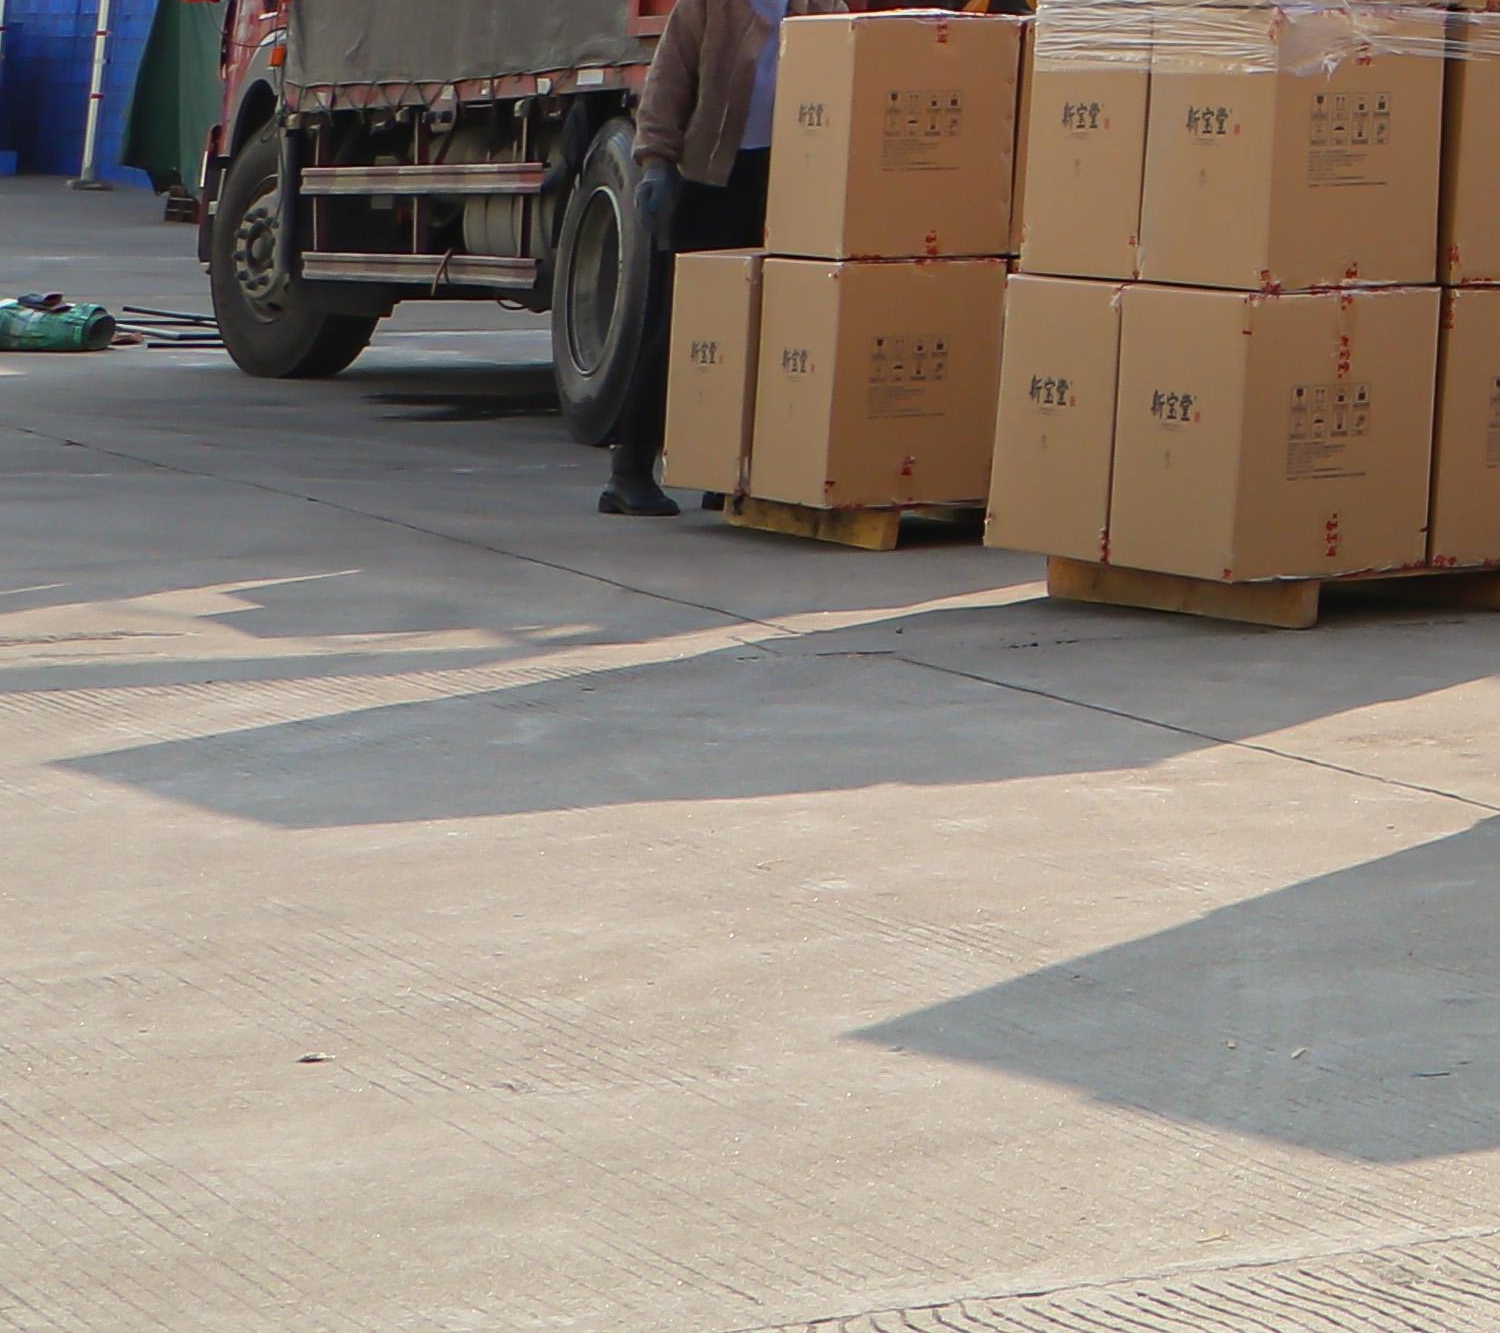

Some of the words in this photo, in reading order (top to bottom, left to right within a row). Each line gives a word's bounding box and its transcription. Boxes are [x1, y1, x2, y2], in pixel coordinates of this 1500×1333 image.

[798, 103, 824, 127] 新宝堂
[1062, 102, 1101, 129] 新宝堂
[1186, 106, 1229, 135] 新宝堂
[690, 341, 717, 365] 新宝堂
[783, 349, 808, 374] 新宝堂
[1029, 375, 1069, 406] 新宝堂
[1151, 390, 1193, 421] 新宝堂
